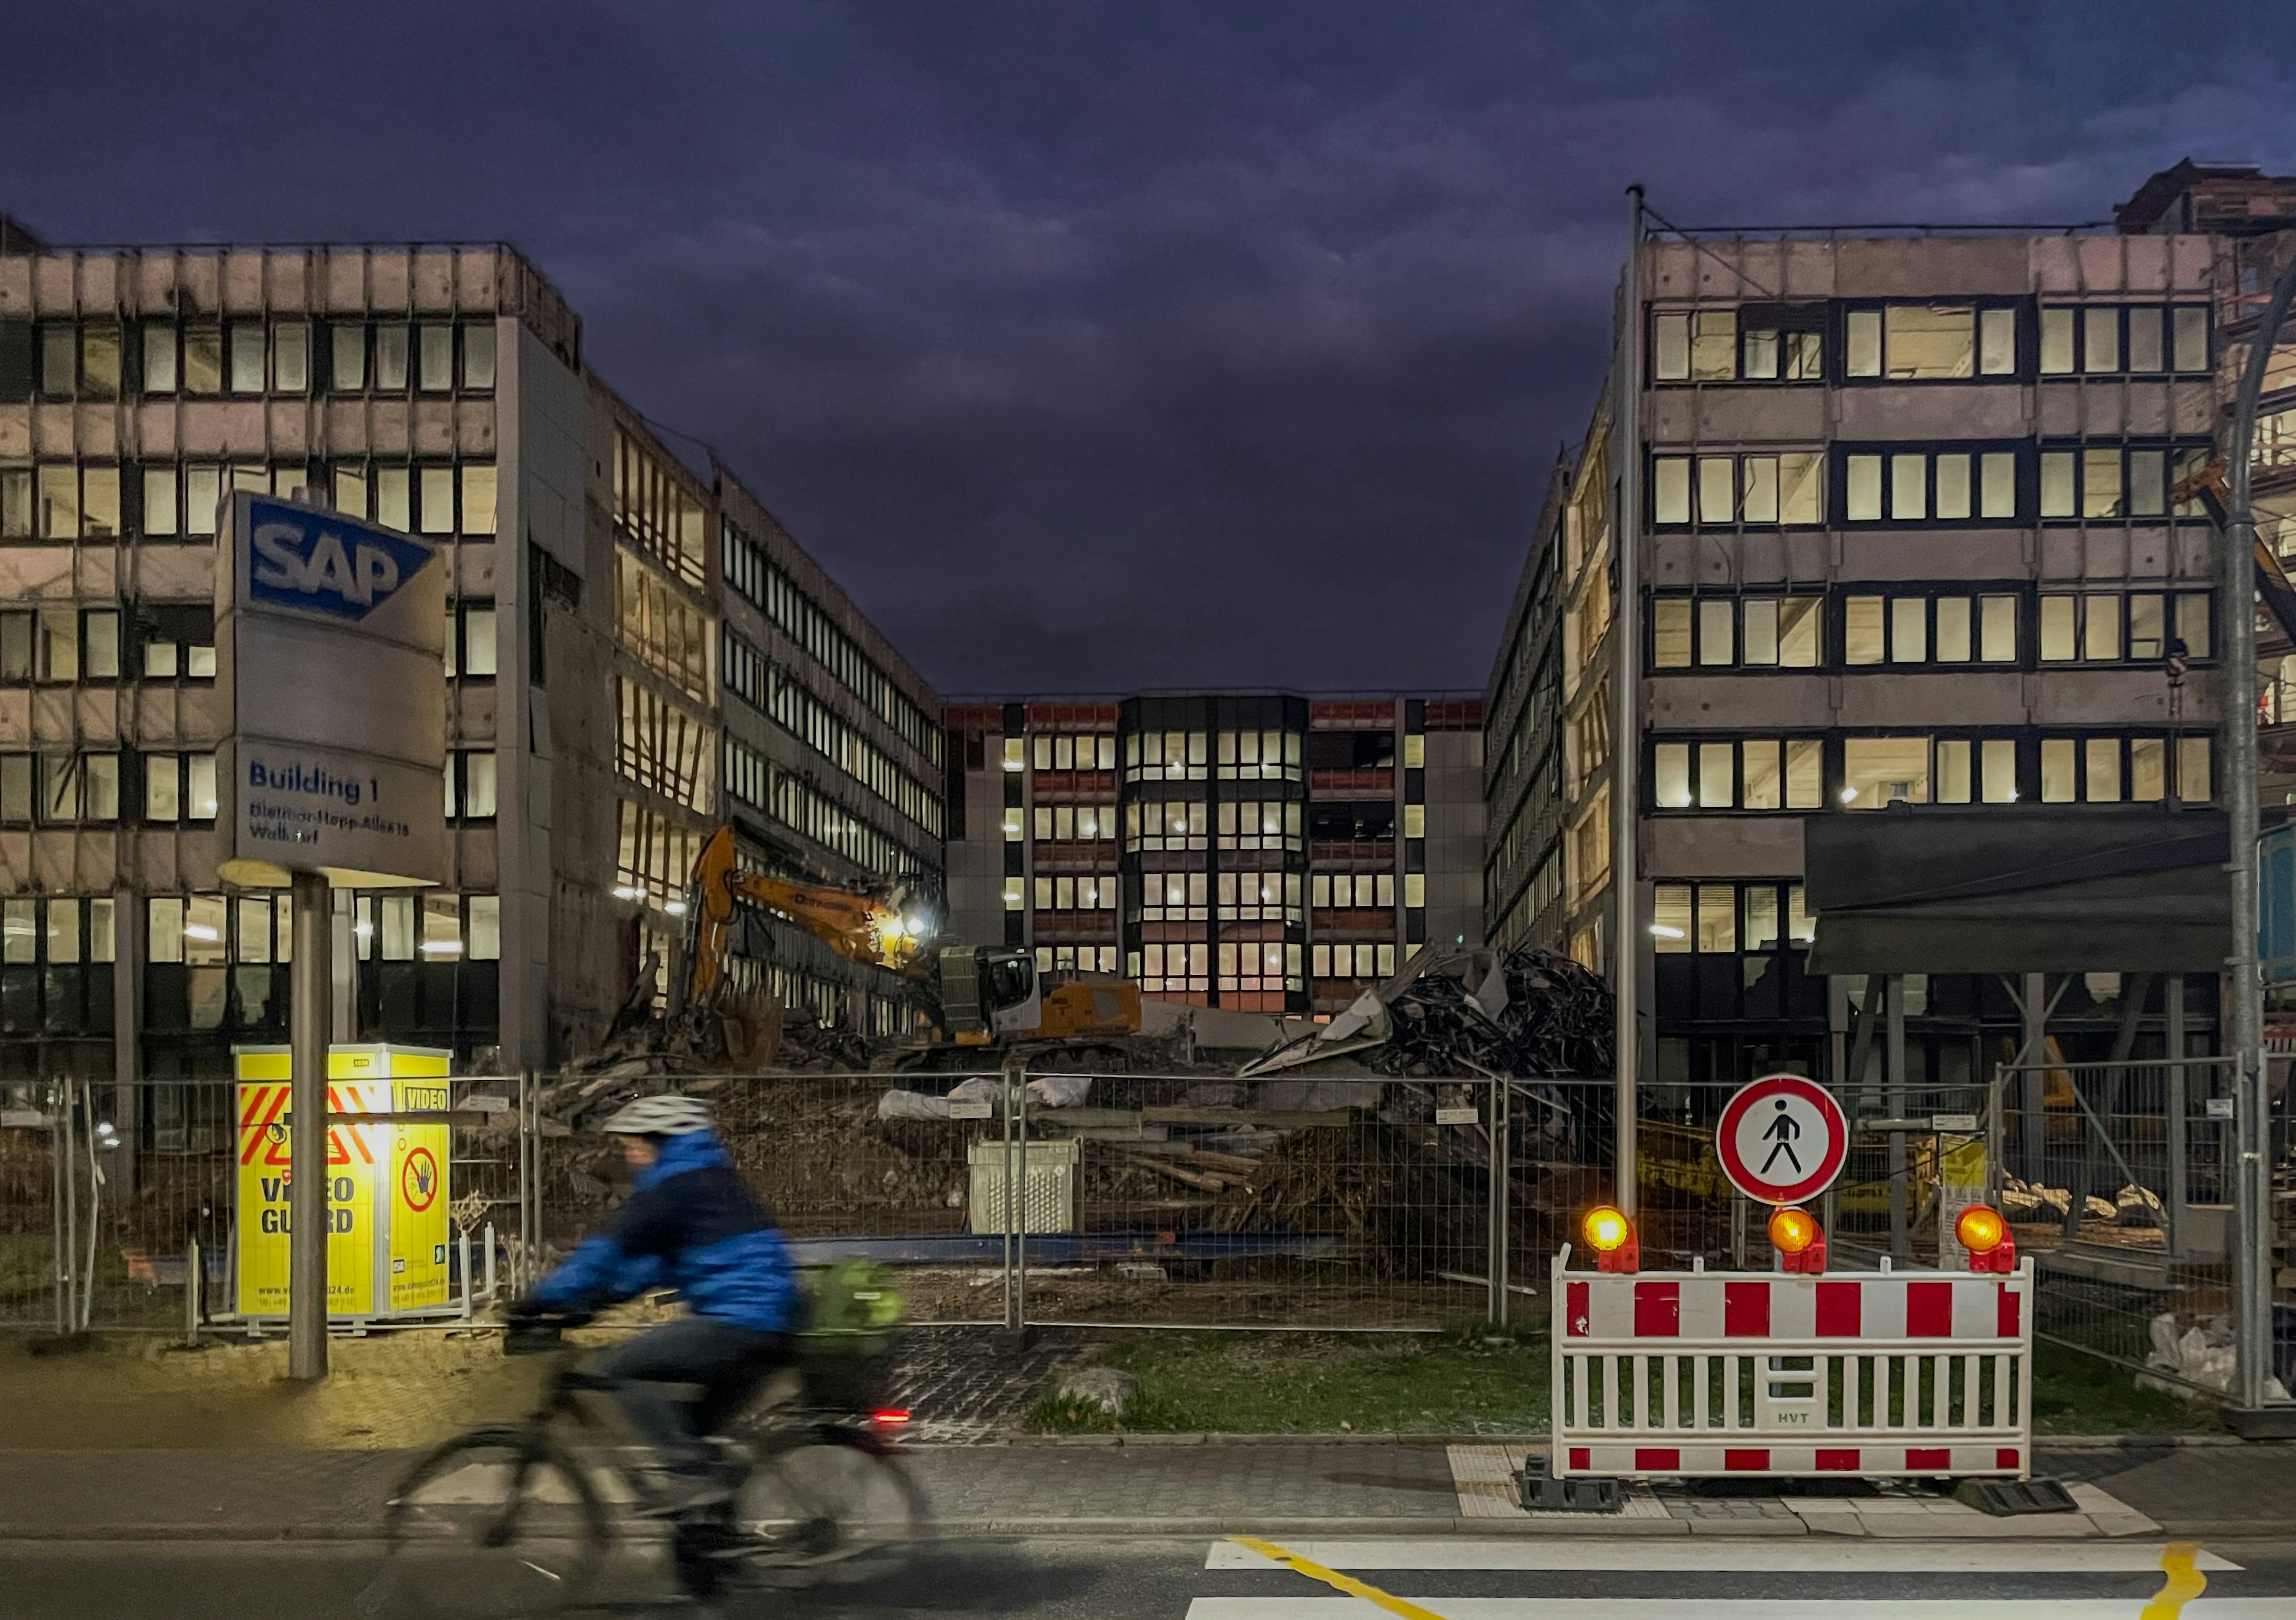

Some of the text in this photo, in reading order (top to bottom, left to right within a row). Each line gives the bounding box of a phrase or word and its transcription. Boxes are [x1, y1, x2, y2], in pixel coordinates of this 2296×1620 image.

[253, 523, 399, 606] SAP
[250, 760, 377, 805] Building 1
[249, 822, 318, 844] Wallrf
[407, 1088, 446, 1110] VIDEO
[261, 1177, 354, 1202] VIO
[262, 1209, 353, 1234] GUD
[1778, 1413, 1810, 1423] HVT
